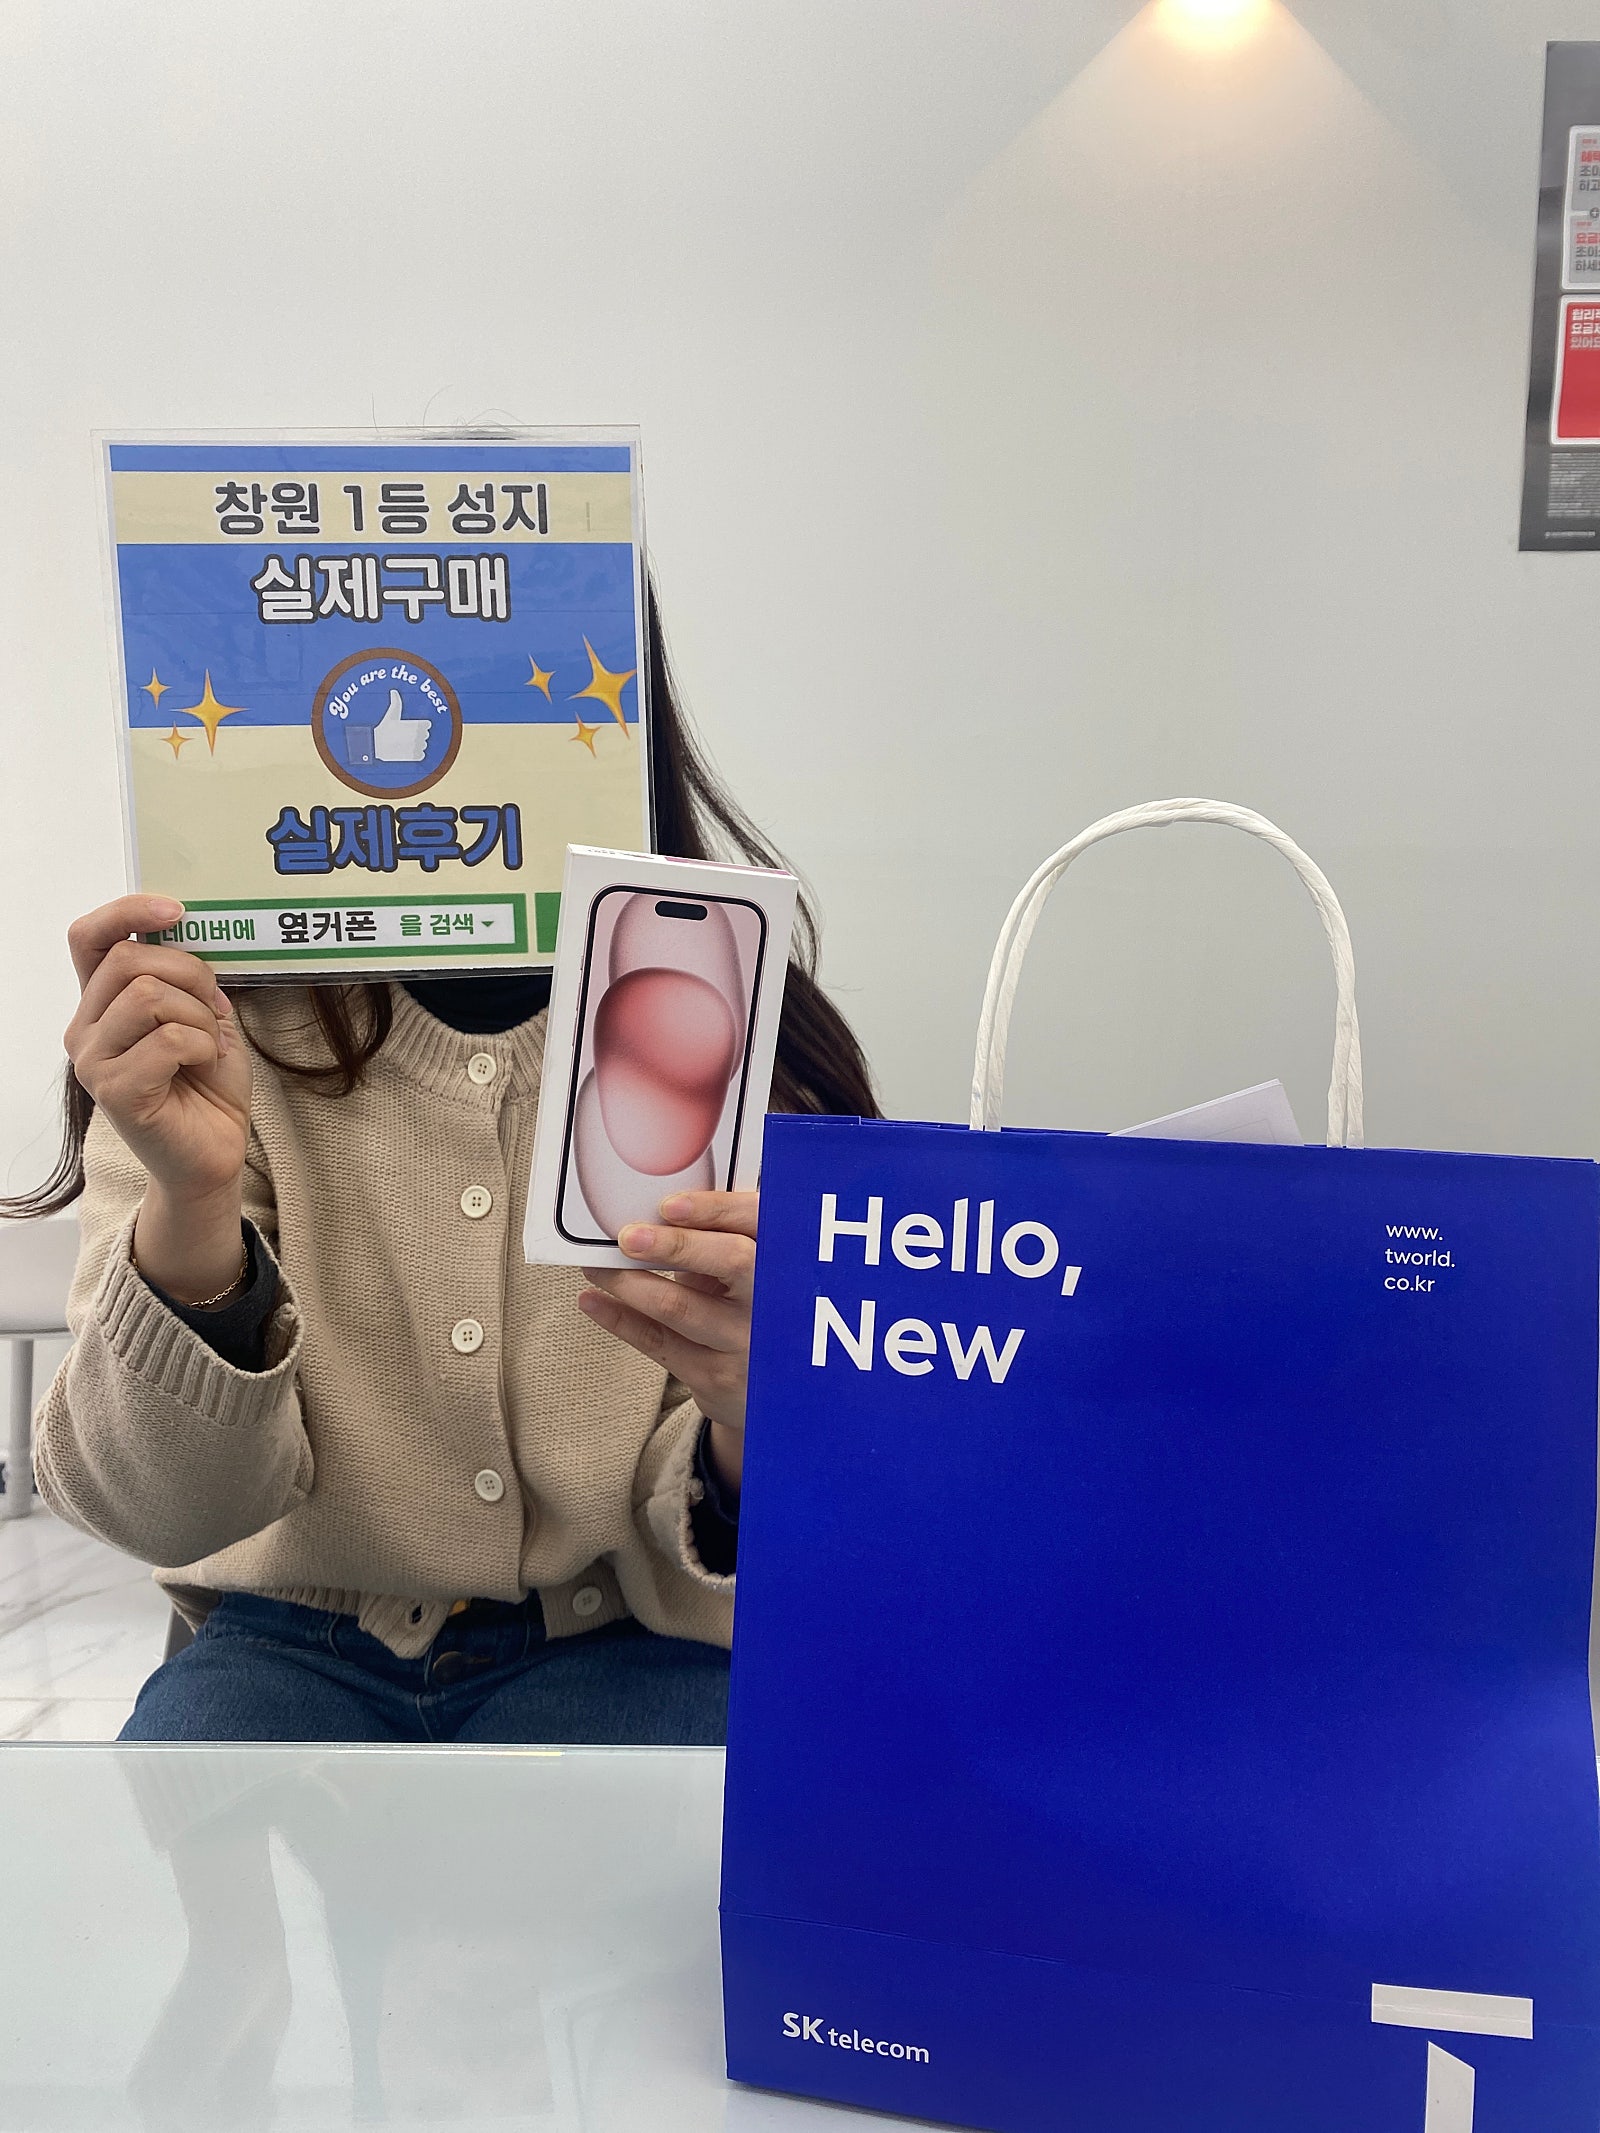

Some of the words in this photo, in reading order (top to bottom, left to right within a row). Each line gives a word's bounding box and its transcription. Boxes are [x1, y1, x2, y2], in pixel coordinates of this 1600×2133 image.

[1576, 232, 1600, 244] 요금
[215, 481, 320, 535] 창원
[343, 483, 430, 535] 1등
[447, 483, 548, 535] 성지
[251, 553, 512, 624] 실제구매
[329, 682, 358, 720] You
[360, 668, 387, 686] are
[391, 664, 418, 685] the
[420, 678, 449, 714] best
[265, 803, 523, 875] 실제후기
[278, 911, 378, 944] 옆커폰
[400, 914, 422, 936] 을
[429, 913, 475, 936] 검색
[818, 1193, 1082, 1296] Hello,
[1385, 1224, 1443, 1241] www.
[1385, 1248, 1456, 1268] tworld.
[1384, 1274, 1436, 1293] co.kr
[811, 1296, 1026, 1384] New
[782, 2012, 825, 2044] SK
[827, 2028, 930, 2063] telecom
